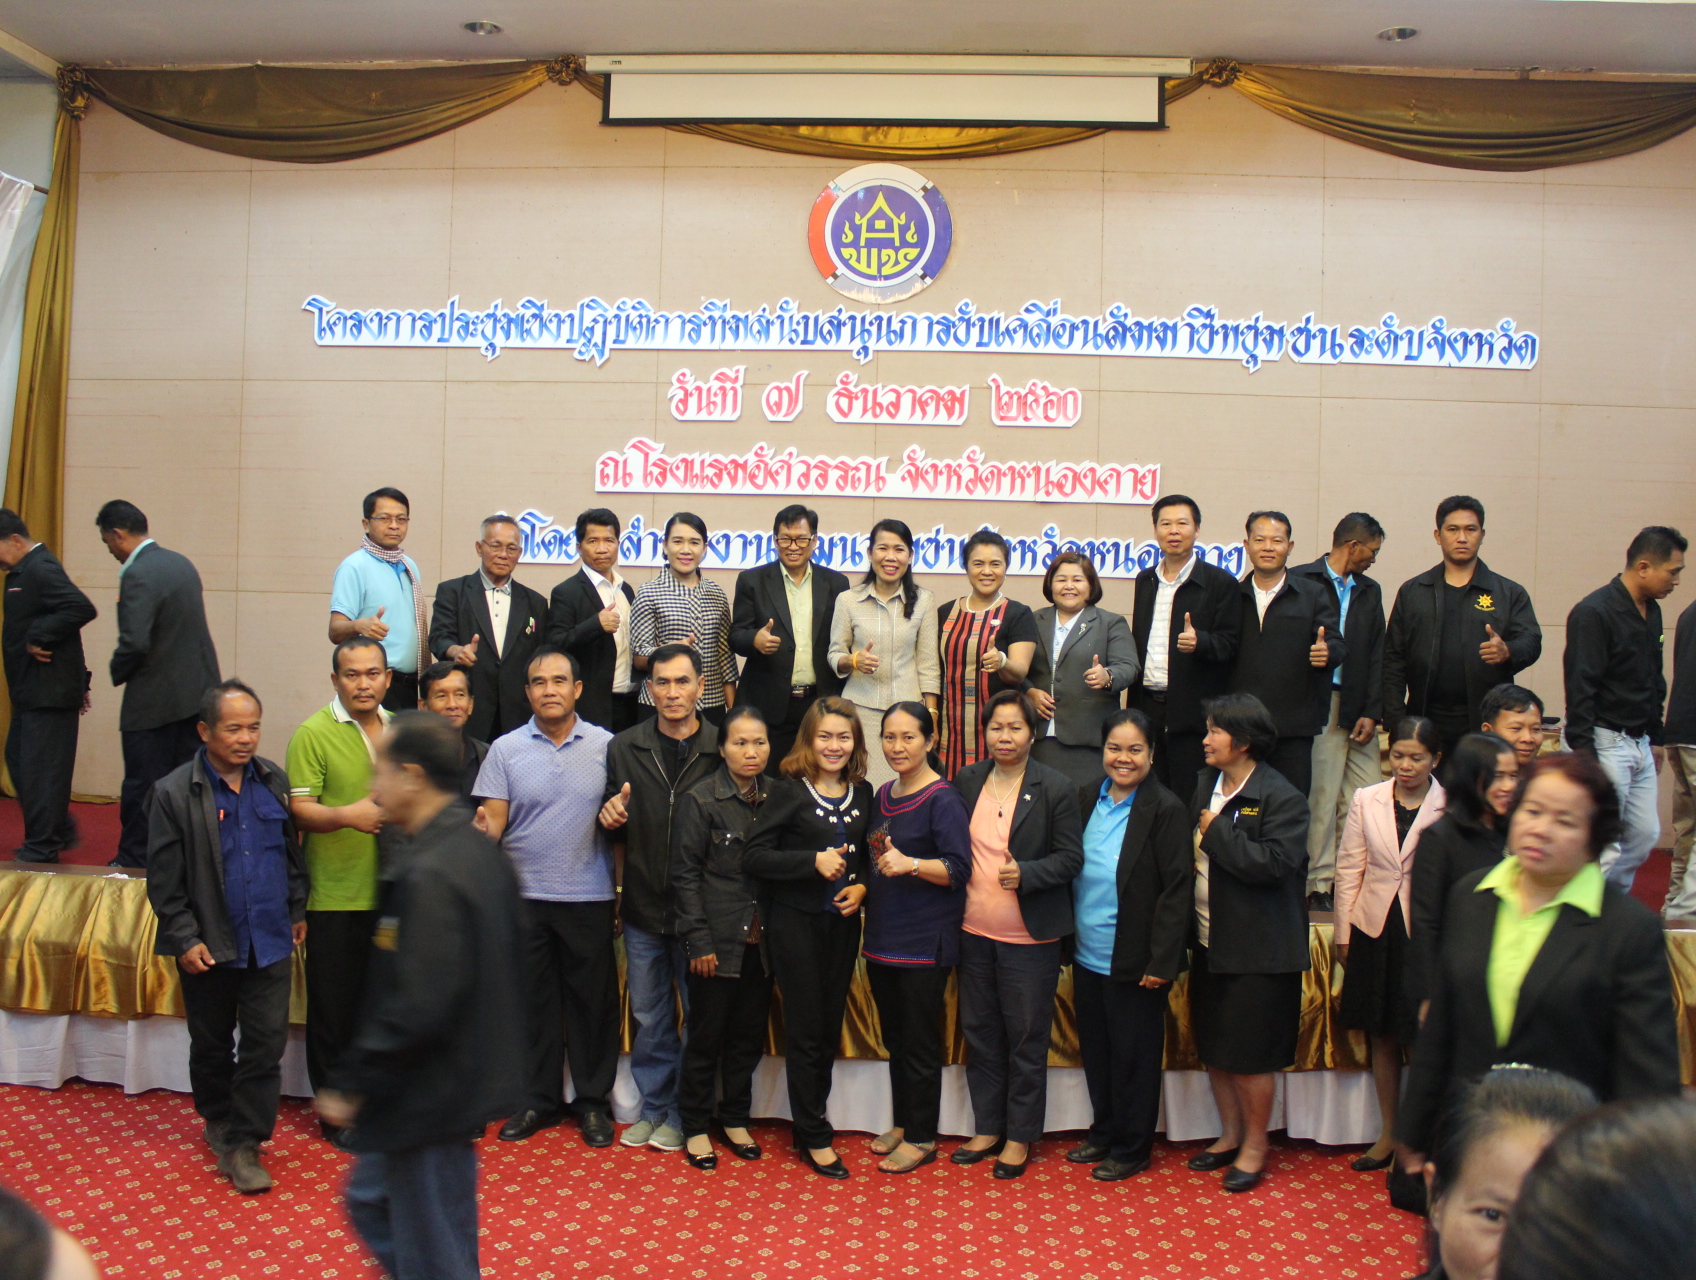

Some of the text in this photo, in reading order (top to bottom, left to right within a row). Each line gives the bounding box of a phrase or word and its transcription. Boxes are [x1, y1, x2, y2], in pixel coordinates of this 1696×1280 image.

[670, 368, 1079, 423] วันที่ ๗ ธันวาคม ๒๕๖๐
[899, 448, 1159, 500] จังหวัดหนองคาย
